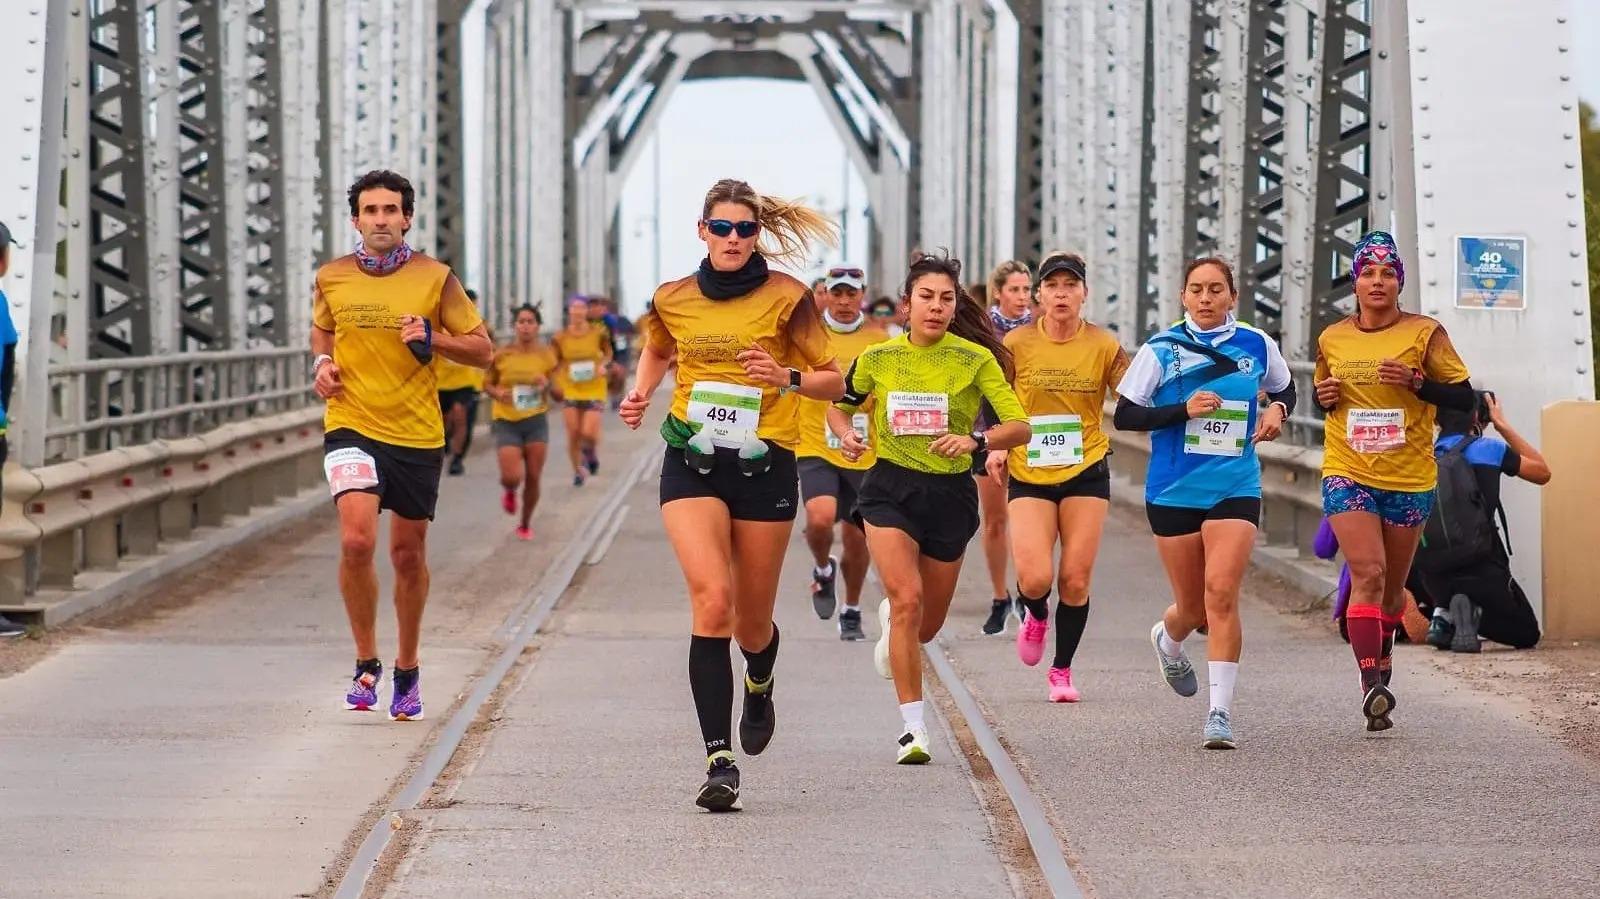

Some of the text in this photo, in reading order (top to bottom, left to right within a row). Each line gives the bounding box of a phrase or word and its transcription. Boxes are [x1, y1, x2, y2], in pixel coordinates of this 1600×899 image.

[1479, 251, 1502, 264] 40
[682, 332, 739, 344] MEDIA
[1030, 368, 1078, 377] MEDIA
[891, 394, 943, 402] MediaMaratón
[706, 406, 737, 424] 494
[904, 411, 931, 425] 113
[1203, 421, 1230, 434] 467
[1363, 426, 1388, 440] 118
[1041, 434, 1066, 447] 499
[342, 463, 359, 476] 68
[1360, 657, 1376, 669] SOX
[706, 738, 726, 748] SOX
